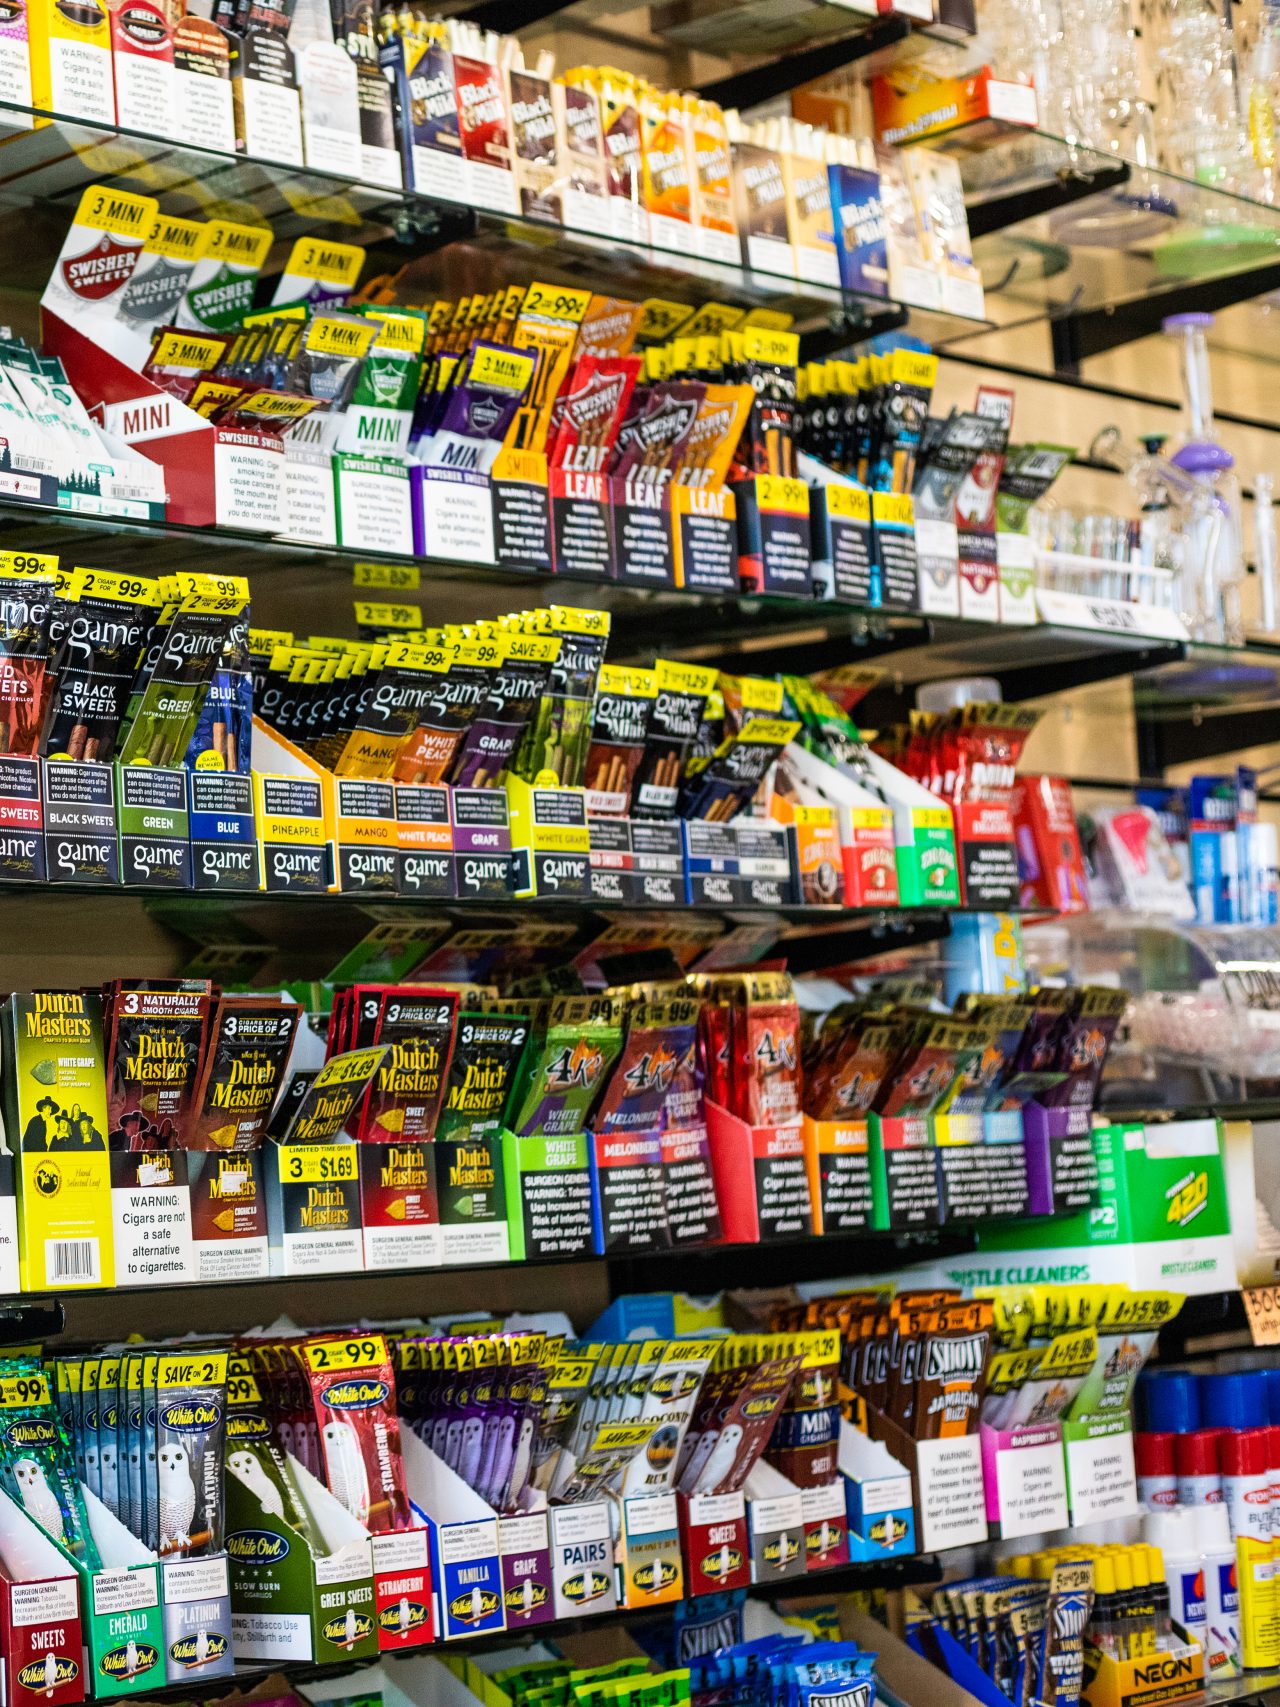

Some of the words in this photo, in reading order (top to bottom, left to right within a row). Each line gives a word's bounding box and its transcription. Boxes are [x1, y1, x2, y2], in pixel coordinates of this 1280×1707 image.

[410, 72, 455, 98] Black
[93, 197, 103, 214] 3
[108, 200, 144, 224] MINI
[69, 252, 136, 279] SWISHER
[73, 268, 132, 287] SWEETS
[123, 403, 170, 435] MINI
[358, 416, 401, 442] MINI
[565, 474, 602, 499] LEAF
[690, 492, 725, 516] LEAF
[14, 556, 45, 574] 99¢
[15, 768, 32, 776] product
[1, 808, 39, 820] SWEETS
[50, 812, 79, 824] BLACK
[82, 814, 114, 826] SWEETS
[143, 817, 173, 829] GREEN
[217, 822, 239, 833] BLUE
[273, 825, 319, 837] PINEAPPLE
[355, 827, 388, 837] MANGO
[472, 834, 498, 845] GRAPE
[348, 852, 394, 884] game
[35, 994, 83, 1014] Dutch
[124, 993, 139, 1013] 3
[144, 996, 200, 1006] NATURALLY
[174, 1007, 198, 1015] CIGARS
[387, 1005, 399, 1022] 3
[401, 1012, 422, 1020] PRICE
[437, 1006, 449, 1024] 2
[27, 1014, 90, 1038] Masters
[58, 1058, 75, 1068] WHITE
[77, 1057, 95, 1068] GRAPE
[546, 1141, 576, 1152] WHITE
[290, 1158, 302, 1177] 3
[320, 1157, 352, 1178] $1.69
[546, 1153, 577, 1165] GRAPE
[131, 1196, 179, 1207] WARNING:
[308, 1187, 344, 1207] Dutch
[123, 1212, 153, 1224] Cigars
[155, 1213, 171, 1222] are
[173, 1212, 185, 1222] not
[300, 1207, 348, 1226] Masters
[152, 1229, 171, 1239] safe
[133, 1245, 180, 1256] alternative
[128, 1264, 137, 1273] to
[139, 1261, 186, 1274] cigarettes.
[1006, 1266, 1089, 1283] CLEANERS
[165, 1365, 191, 1382] SAVE
[202, 1363, 214, 1381] 2
[928, 1394, 979, 1413] JAMAICAN
[944, 1409, 967, 1421] BUZZ
[374, 1423, 396, 1492] STRAWBERRY
[205, 1451, 216, 1518] PLATINUM
[227, 1539, 255, 1557] White
[257, 1537, 279, 1556] Owl
[564, 1543, 606, 1566] PAIRS
[458, 1566, 489, 1584] VANILLA
[234, 1582, 255, 1590] SLOW
[258, 1582, 280, 1590] BURN
[321, 1590, 345, 1609] GREEN
[347, 1587, 372, 1604] SWEETS
[178, 1604, 220, 1624] PLATINUM
[109, 1614, 148, 1635] EMERALD
[31, 1629, 65, 1649] SWEETS
[1135, 1657, 1192, 1687] NEON
